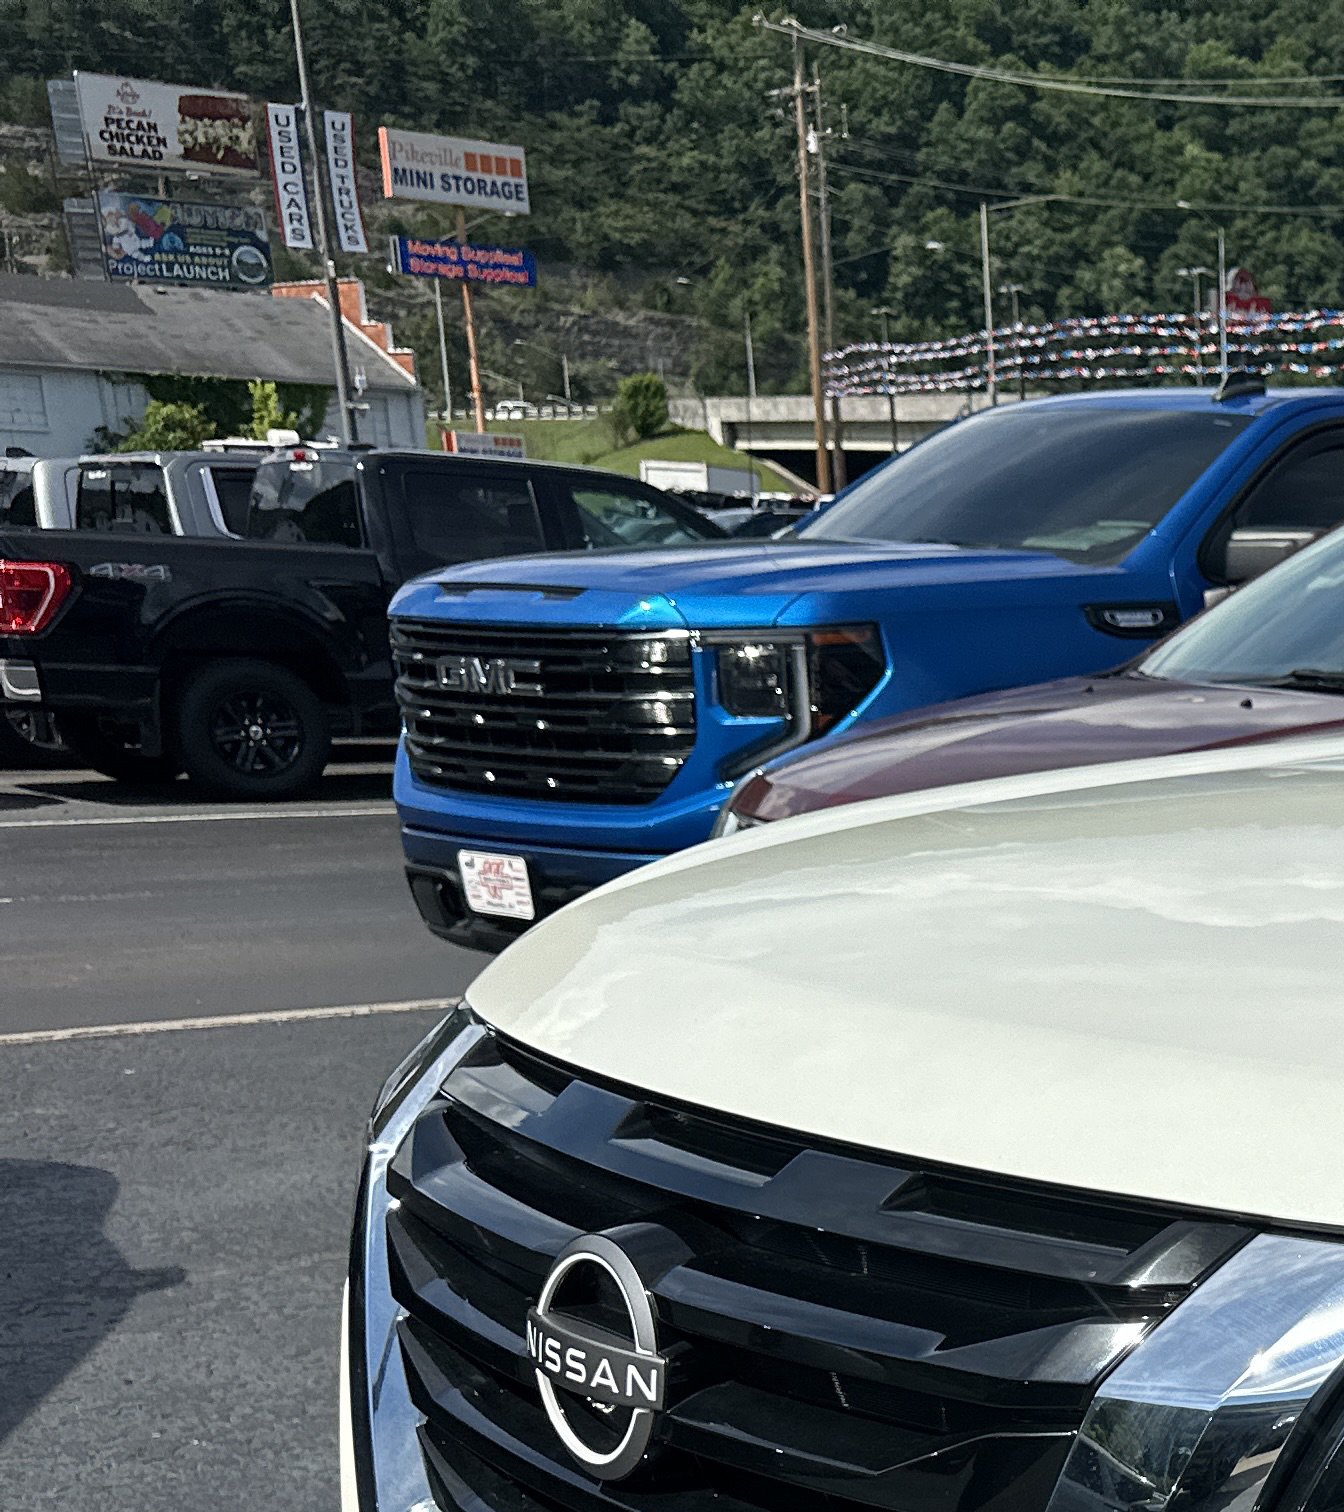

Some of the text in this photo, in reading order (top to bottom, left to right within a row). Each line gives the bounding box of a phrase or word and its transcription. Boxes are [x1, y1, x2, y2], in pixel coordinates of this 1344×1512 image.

[104, 116, 158, 134] PECAN
[99, 130, 168, 149] CHICKEN
[107, 144, 163, 161] SALAD
[391, 140, 462, 169] Pikeville
[274, 114, 305, 241] USED CARS
[331, 120, 360, 246] USED TRUCKS
[393, 167, 526, 201] MINI STORAGE
[407, 240, 458, 260] Moving
[108, 259, 230, 281] Project LAUNCH
[410, 257, 464, 278] Storage
[436, 655, 543, 696] GMC
[526, 1319, 658, 1402] NISSAN
